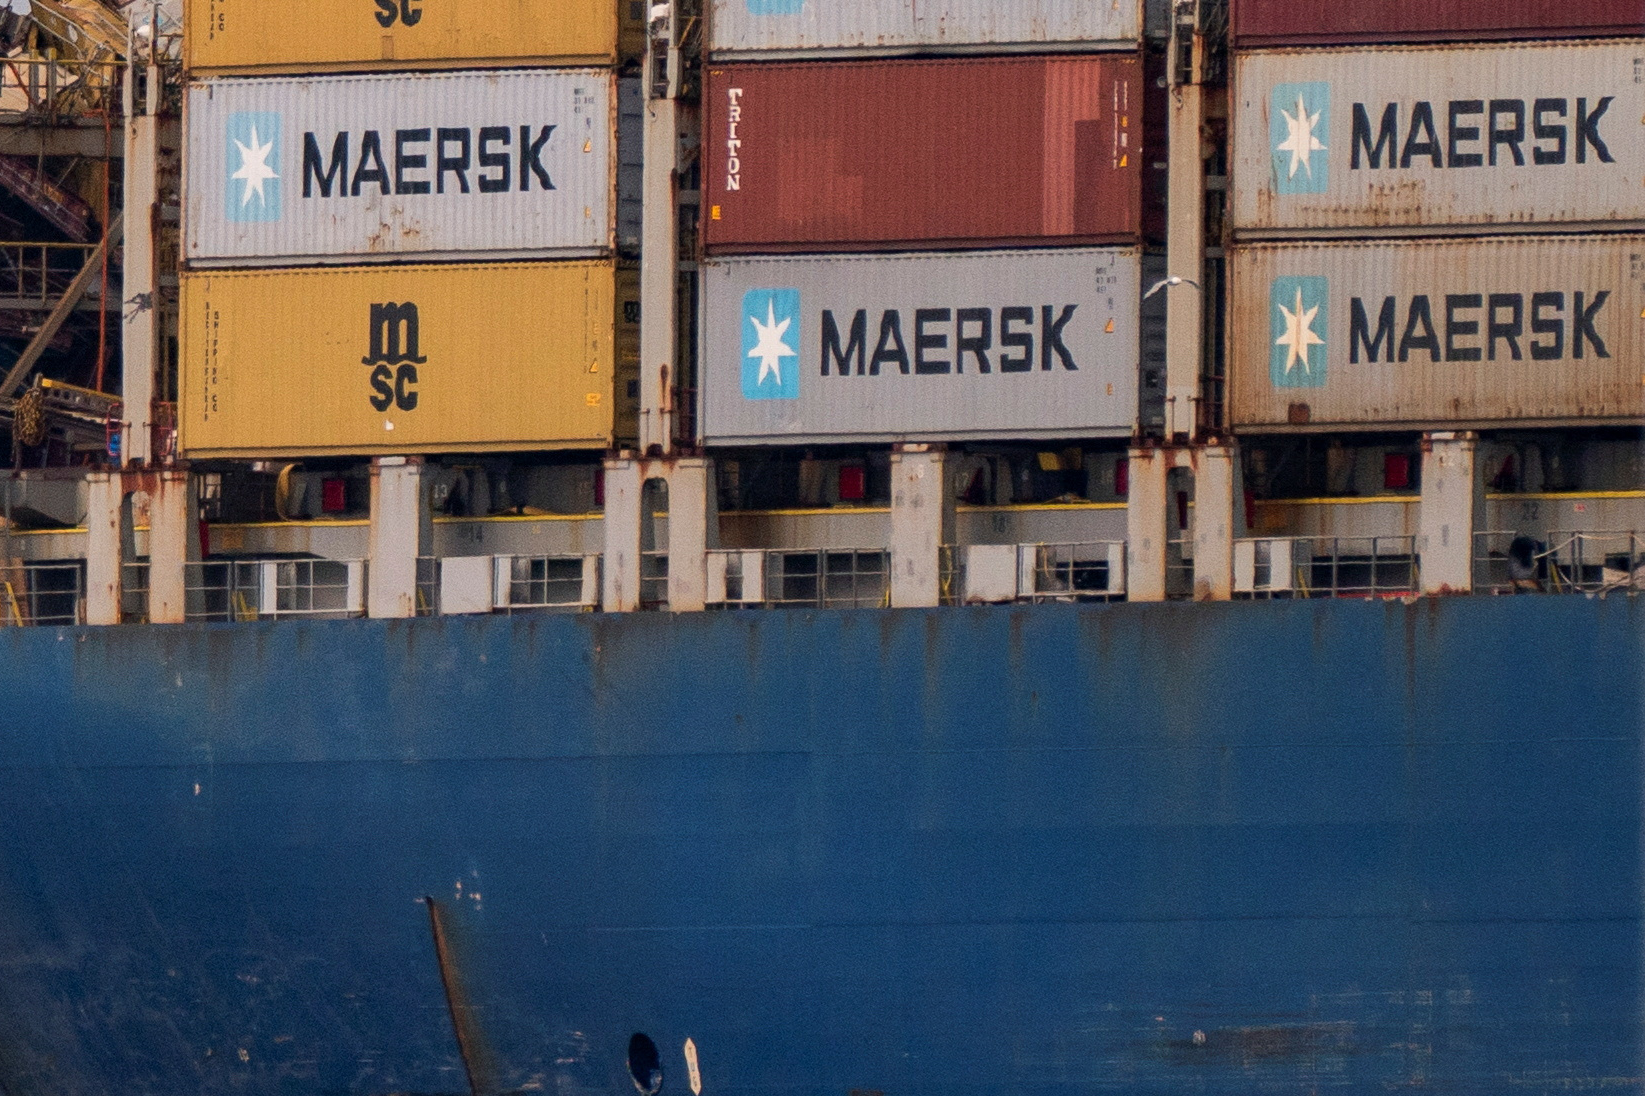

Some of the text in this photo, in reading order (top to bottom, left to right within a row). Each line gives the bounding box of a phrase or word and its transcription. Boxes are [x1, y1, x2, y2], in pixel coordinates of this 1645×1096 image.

[303, 124, 557, 199] MAERSK
[726, 88, 743, 191] TRITON
[1351, 96, 1617, 170] MAERSK
[820, 304, 1079, 377] MAERSK
[1349, 290, 1612, 364] MAERSK
[434, 484, 448, 499] 13
